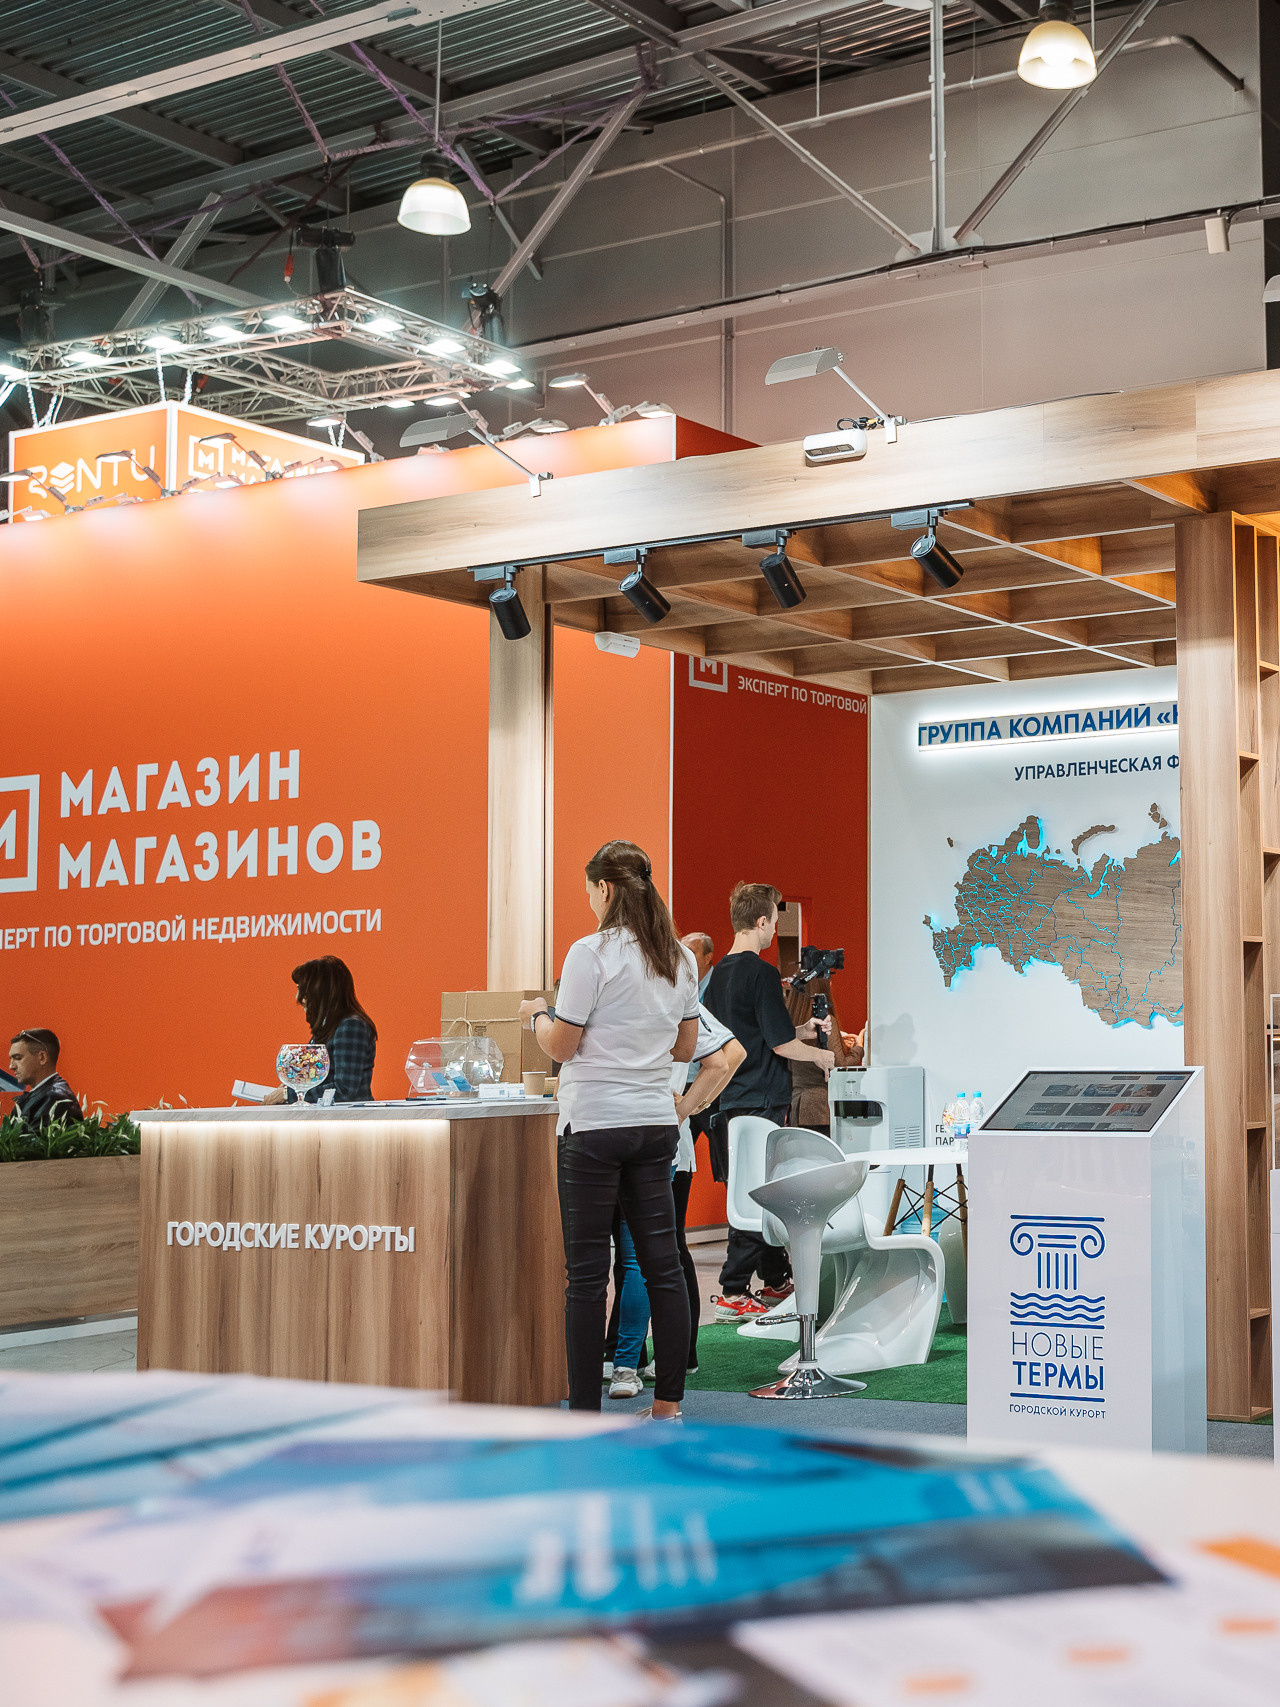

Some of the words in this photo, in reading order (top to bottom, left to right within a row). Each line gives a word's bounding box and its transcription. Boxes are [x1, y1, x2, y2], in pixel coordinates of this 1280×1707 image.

[737, 675, 790, 699] ЭКСПЕРТ
[791, 686, 808, 702] ПО
[809, 690, 867, 715] ТОРГОВОЙ
[917, 720, 1003, 746] ГРУППА
[1009, 702, 1151, 739] КОМПАНИЙ
[60, 748, 301, 818] МАГАЗИН
[1014, 755, 1162, 781] УПРАВЛЕНЧЕСКАЯ
[58, 819, 383, 890] МАГАЗИНОВ
[0, 926, 40, 950] ЕРТ
[44, 924, 72, 948] ПО
[76, 914, 186, 946] ТОРГОВОЙ
[192, 908, 383, 943] НЕДВИЖИМОСТИ
[166, 1221, 300, 1251] ГОРОДСКИЕ
[304, 1223, 416, 1253] КУРОРТЫ
[1012, 1331, 1104, 1361] НОВЫЕ
[1012, 1360, 1104, 1391] ТЕРМЫ
[1009, 1403, 1067, 1417] ГОРОДСКОЙ
[1069, 1408, 1106, 1419] КУРОРТ
